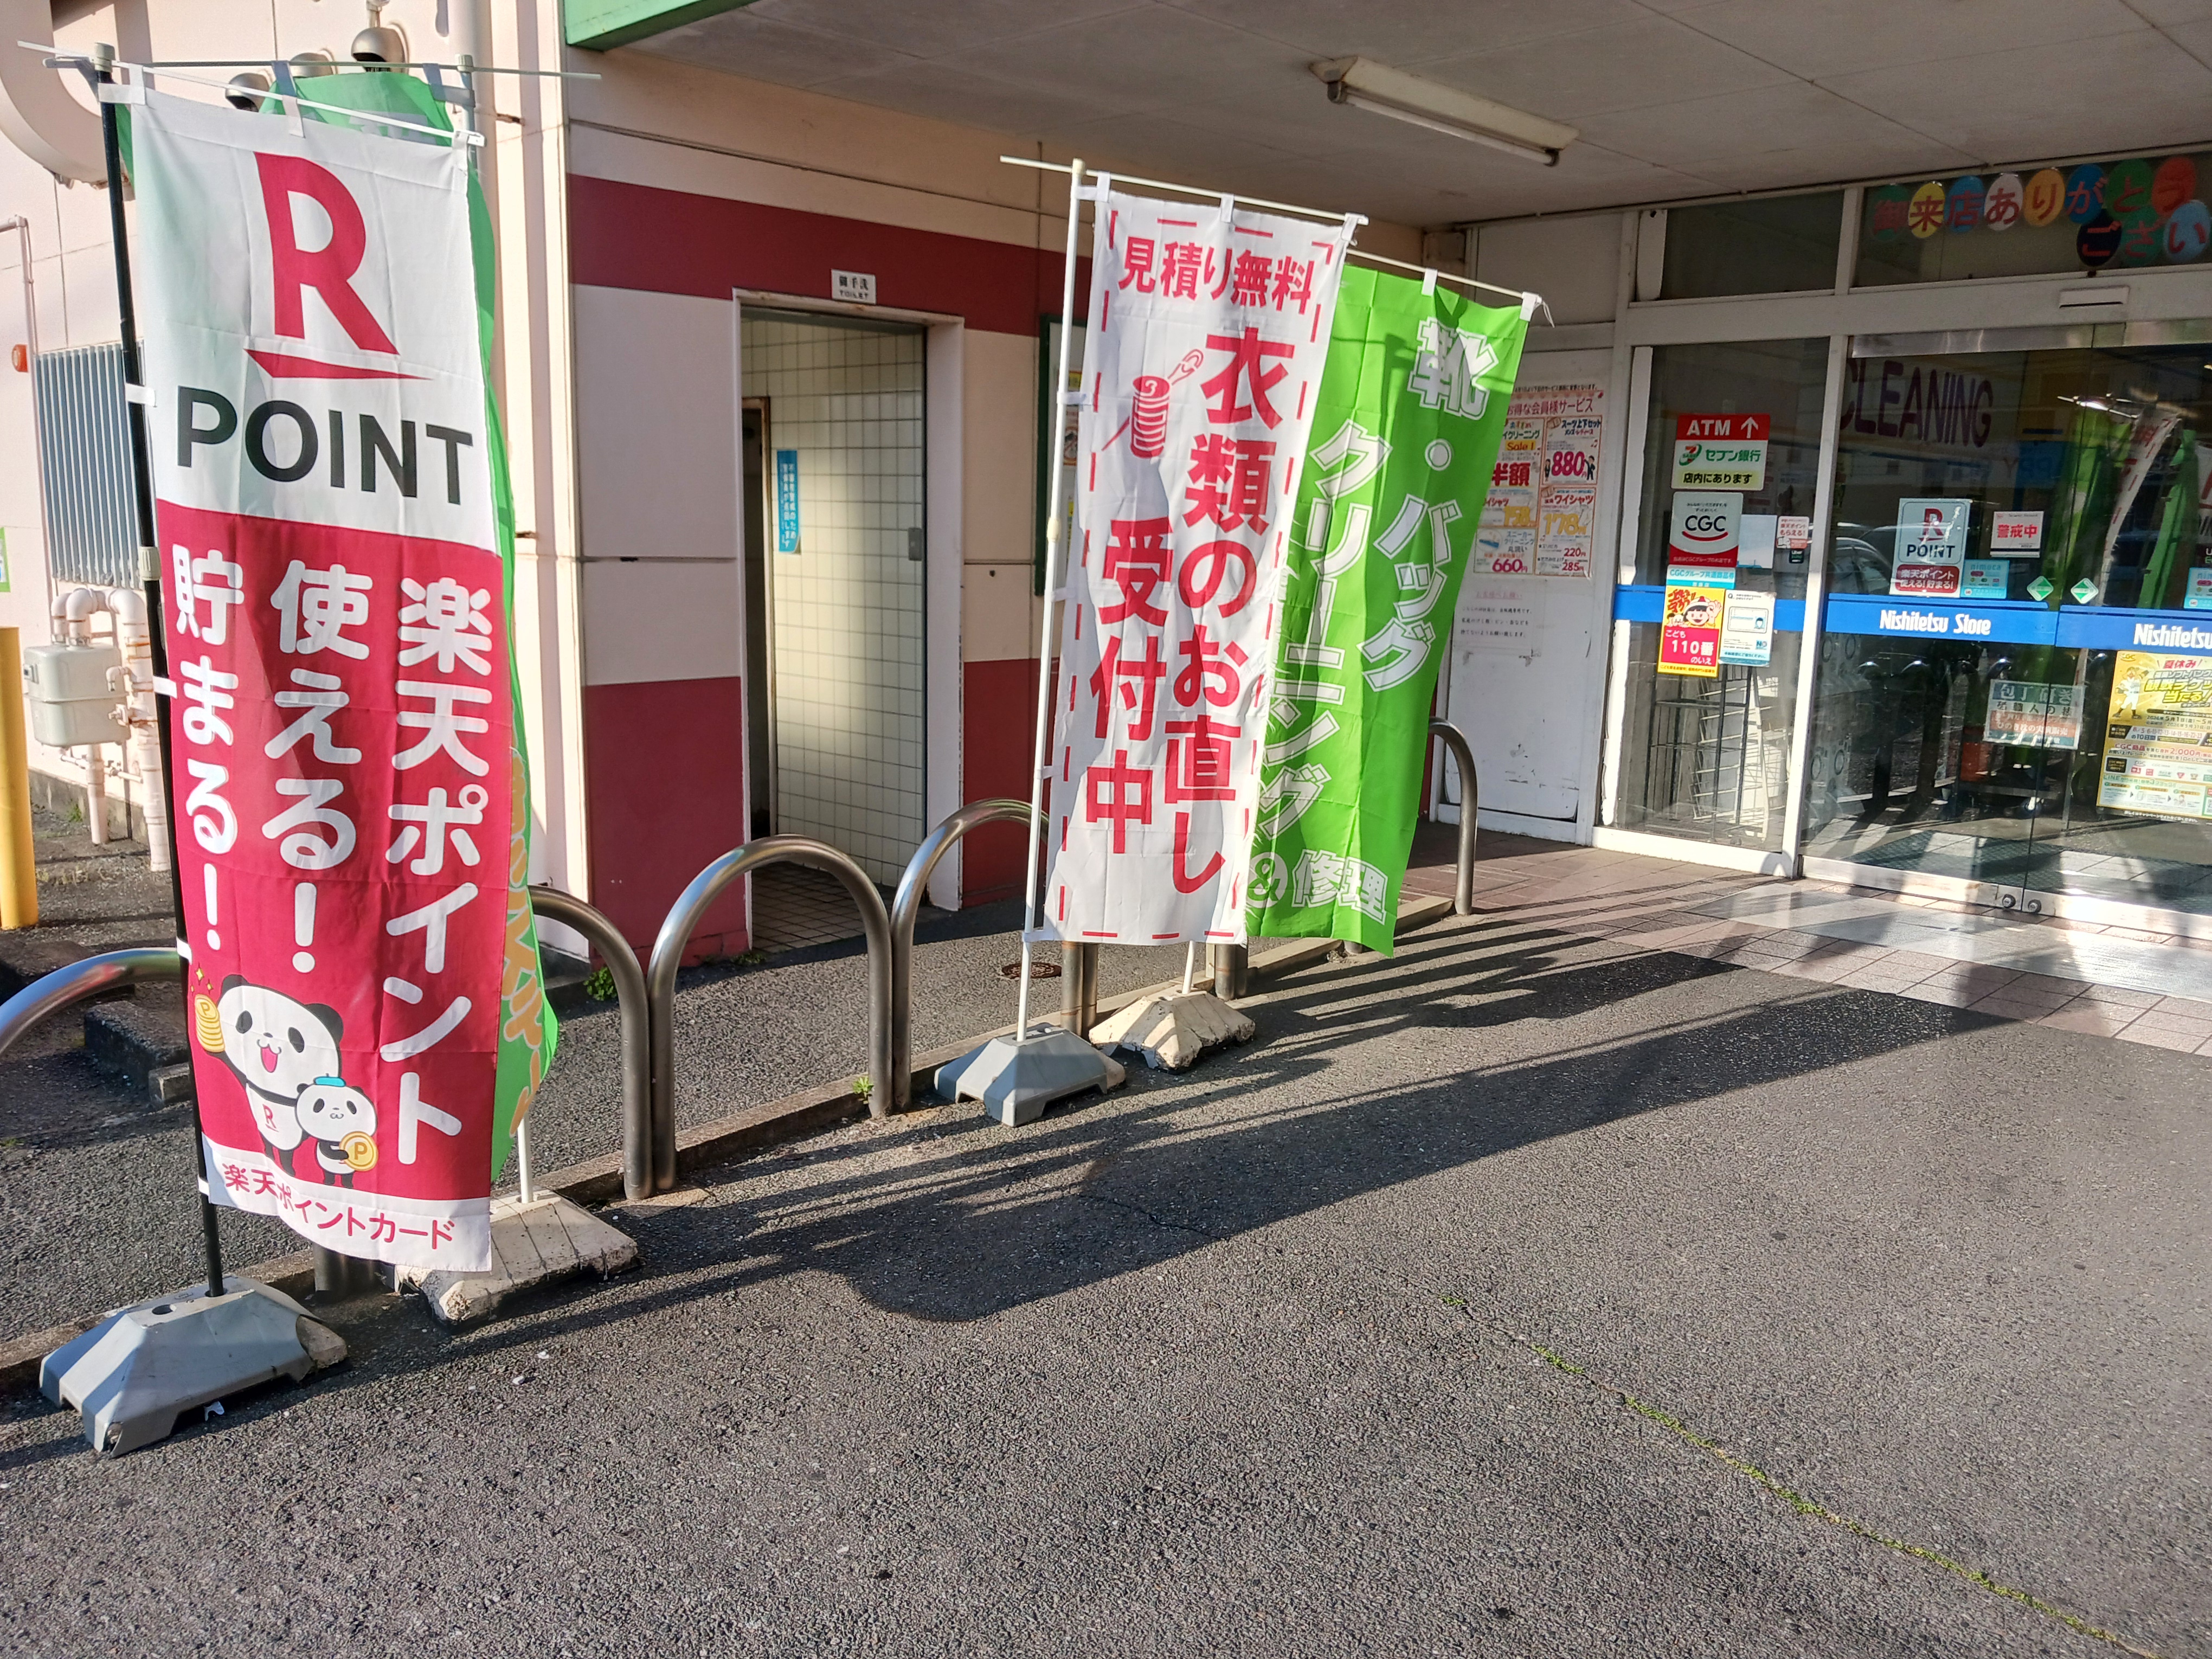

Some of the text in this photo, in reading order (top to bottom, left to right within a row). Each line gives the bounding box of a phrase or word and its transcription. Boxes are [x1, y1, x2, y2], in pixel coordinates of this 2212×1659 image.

[254, 151, 400, 355] R
[1118, 236, 1314, 314] 見積り無料
[1687, 420, 1731, 436] ATM
[177, 385, 473, 505] POINT
[1706, 449, 1761, 462] セブン銀行
[1491, 462, 1531, 486] 半額
[1683, 473, 1753, 484] 店内にあります
[1356, 316, 1499, 693] 靴・バッグ
[1685, 515, 1727, 532] CGC
[1997, 524, 2039, 538] 警戒中
[1906, 544, 1955, 558] POINT
[1165, 327, 1295, 894] 衣類のお直し
[1880, 610, 1991, 635] Nishitetsu Store
[1258, 419, 1392, 841] クリーニング
[1665, 629, 1686, 639] こども
[1671, 639, 1714, 657] 110番
[1690, 656, 1712, 665] のいえ
[1085, 516, 1174, 854] 受付中
[172, 544, 245, 950] 貯まる!
[261, 560, 373, 973] 使える!
[380, 577, 492, 1165] 楽天ポイント
[354, 1141, 368, 1160] P
[222, 1163, 455, 1250] 楽天ポイントカード
